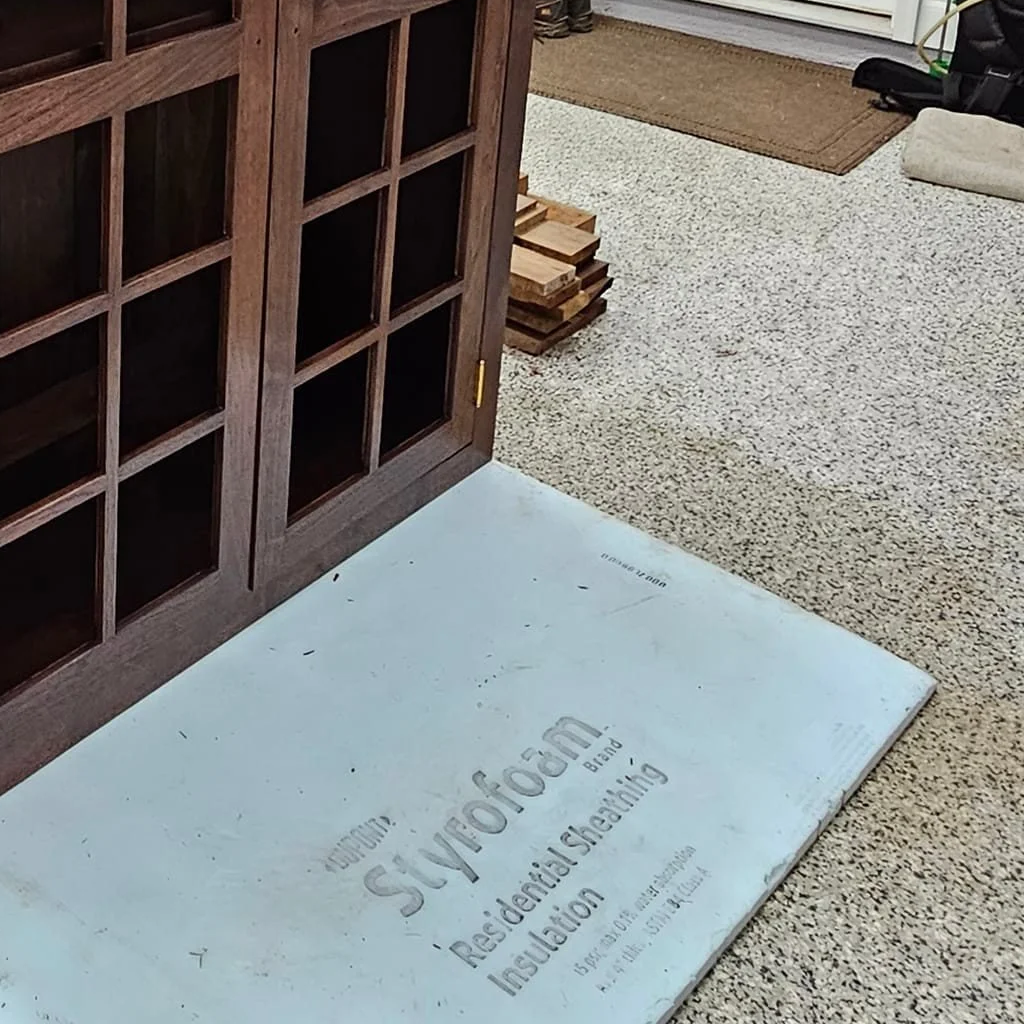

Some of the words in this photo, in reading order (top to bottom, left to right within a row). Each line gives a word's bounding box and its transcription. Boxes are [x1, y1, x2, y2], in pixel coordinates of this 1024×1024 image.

[582, 737, 623, 773] Brand
[449, 846, 573, 968] Residential
[559, 762, 669, 857] Sheathing
[487, 885, 605, 996] Insulation
